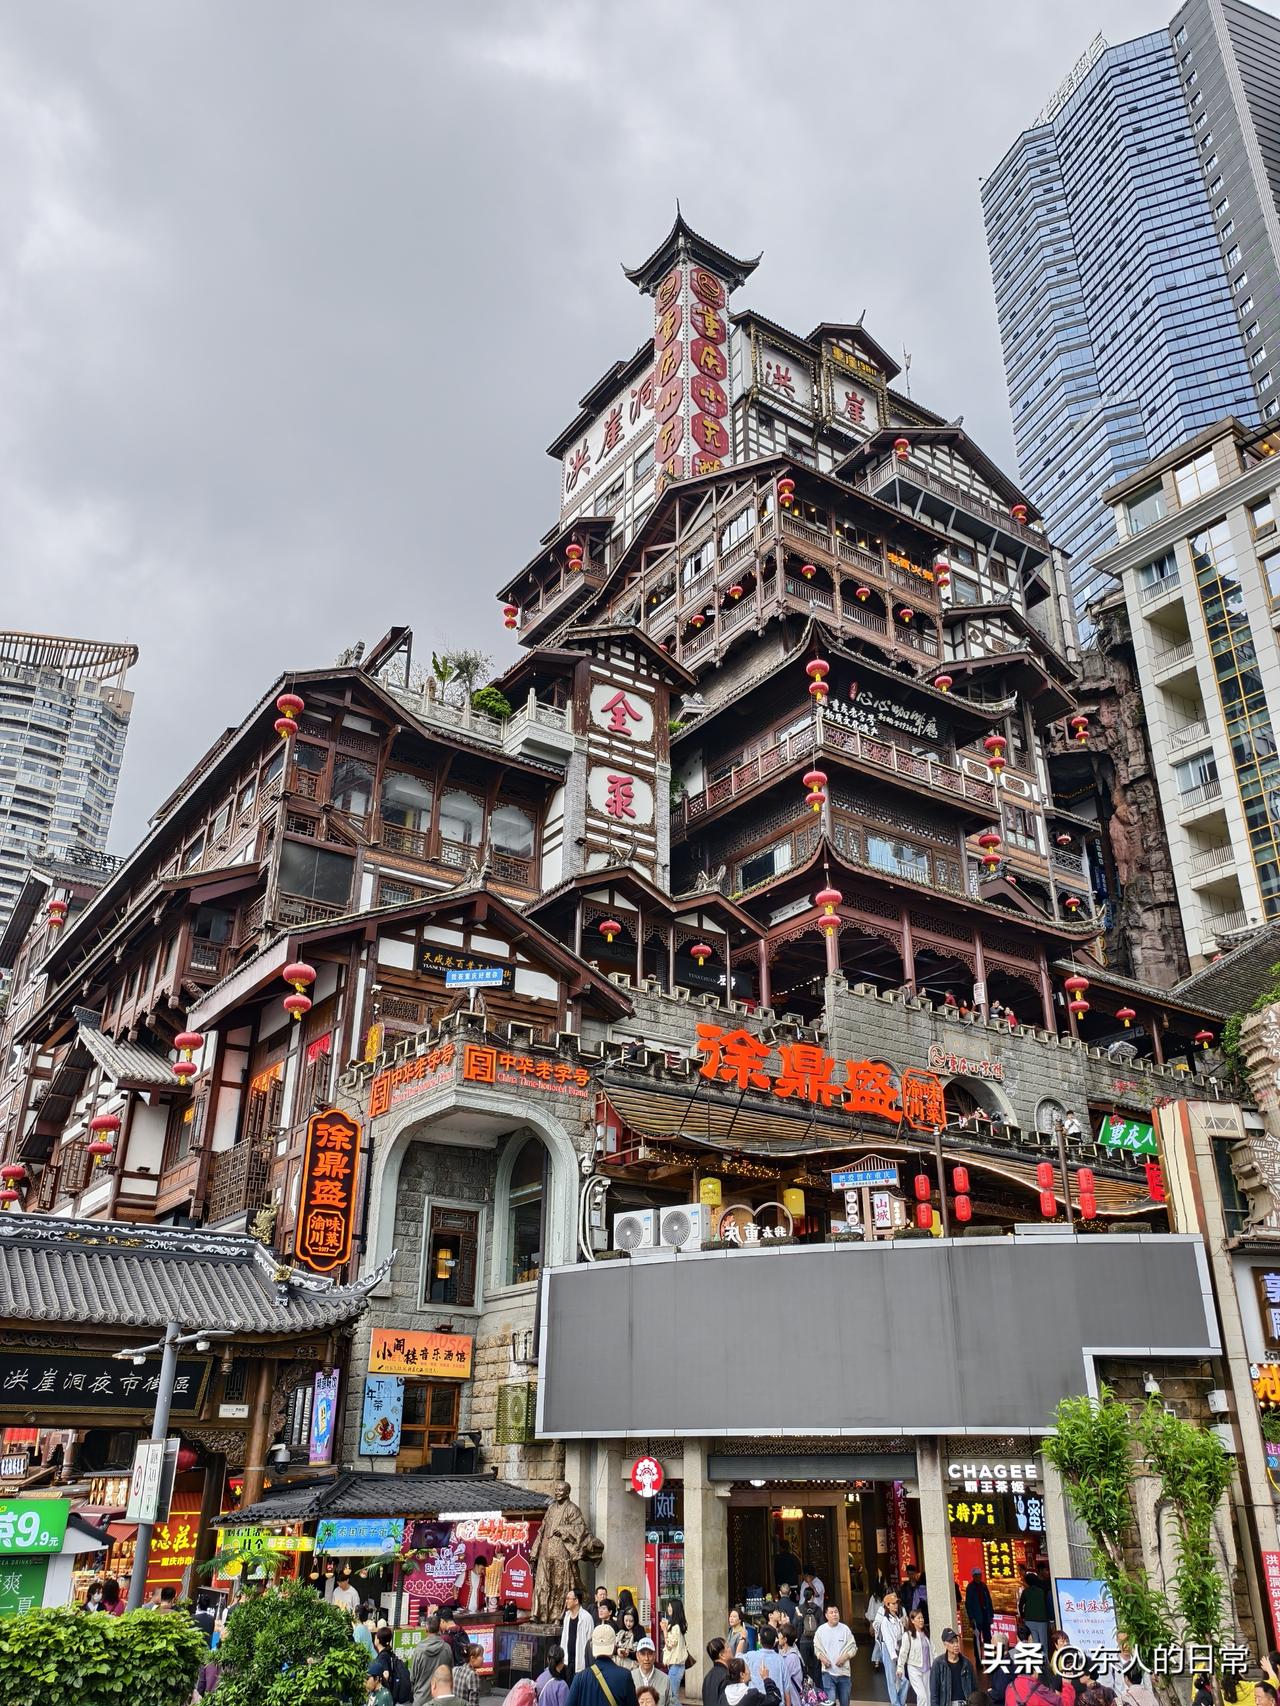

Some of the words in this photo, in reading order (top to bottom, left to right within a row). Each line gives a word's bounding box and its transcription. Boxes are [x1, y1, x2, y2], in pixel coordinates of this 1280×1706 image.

[565, 371, 655, 494] 洪崖洞
[391, 1042, 455, 1089] 中华老字号
[498, 1072, 518, 1084] China
[499, 1052, 590, 1087] 中华老字号
[695, 1023, 903, 1122] 徐鼎盛
[309, 1123, 354, 1209] 徐鼎盛
[948, 1464, 1038, 1479] CHAGEE
[964, 1480, 1026, 1494] 霸王茶姬
